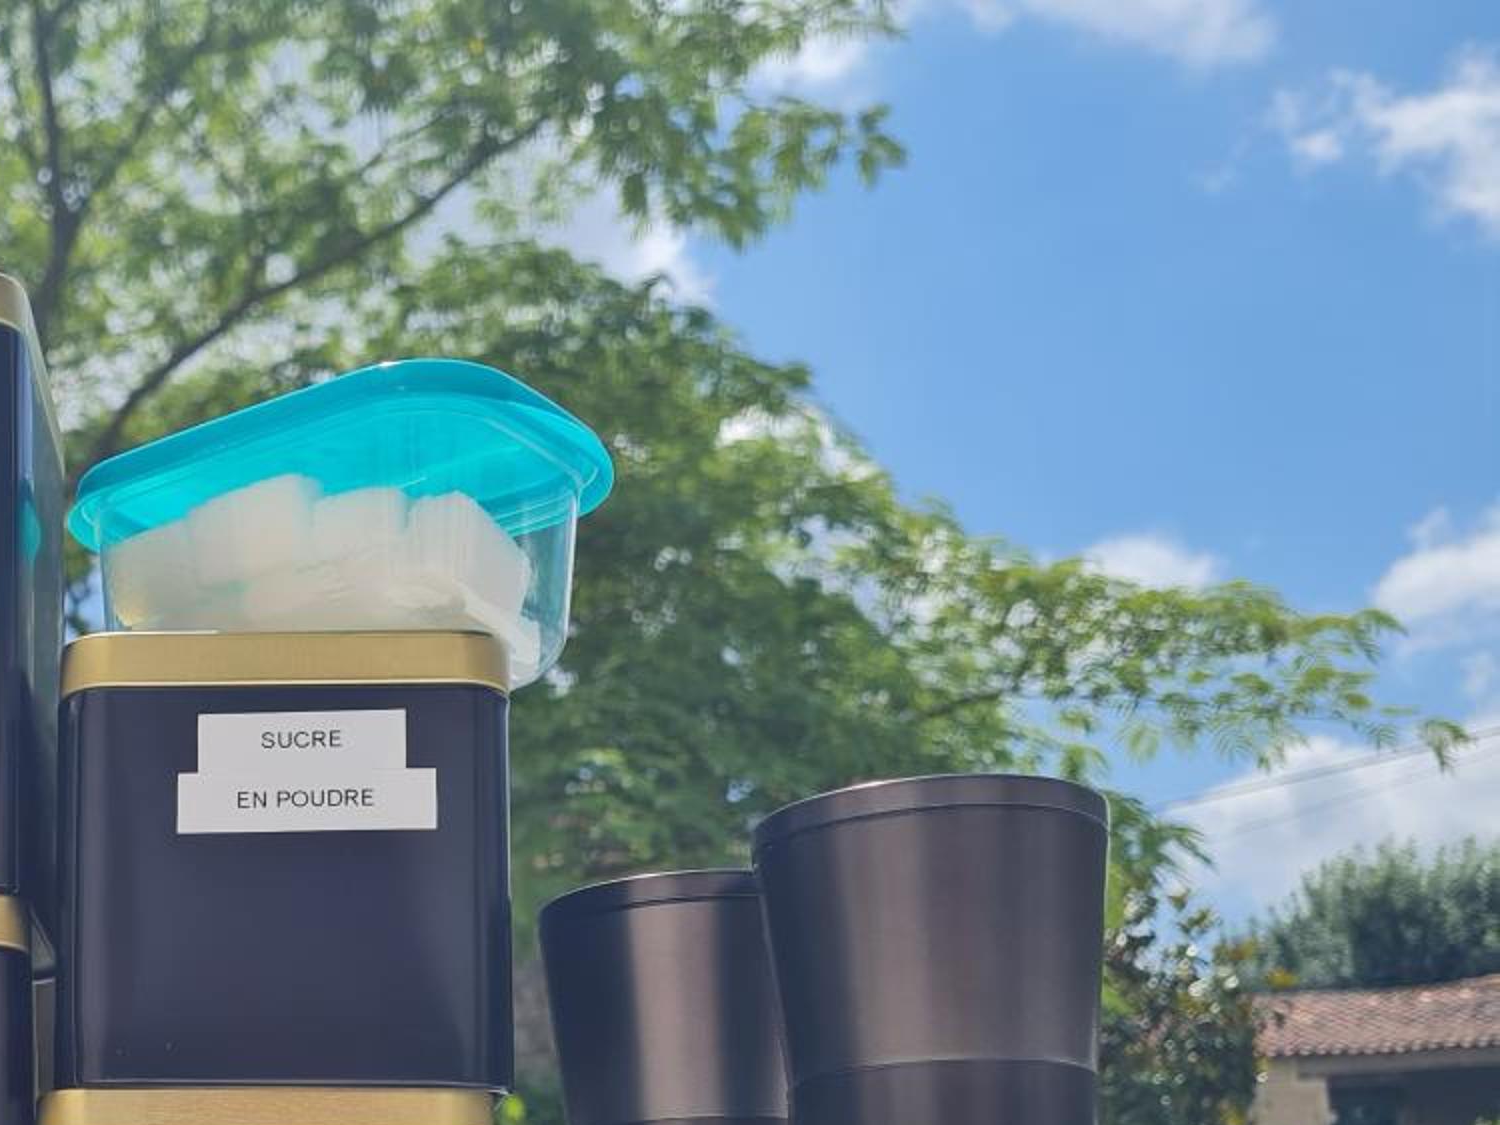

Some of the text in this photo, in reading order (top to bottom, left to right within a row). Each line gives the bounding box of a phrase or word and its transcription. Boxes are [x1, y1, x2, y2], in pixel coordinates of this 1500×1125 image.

[260, 729, 343, 750] SUCRE
[236, 788, 375, 809] EN POUDRE
